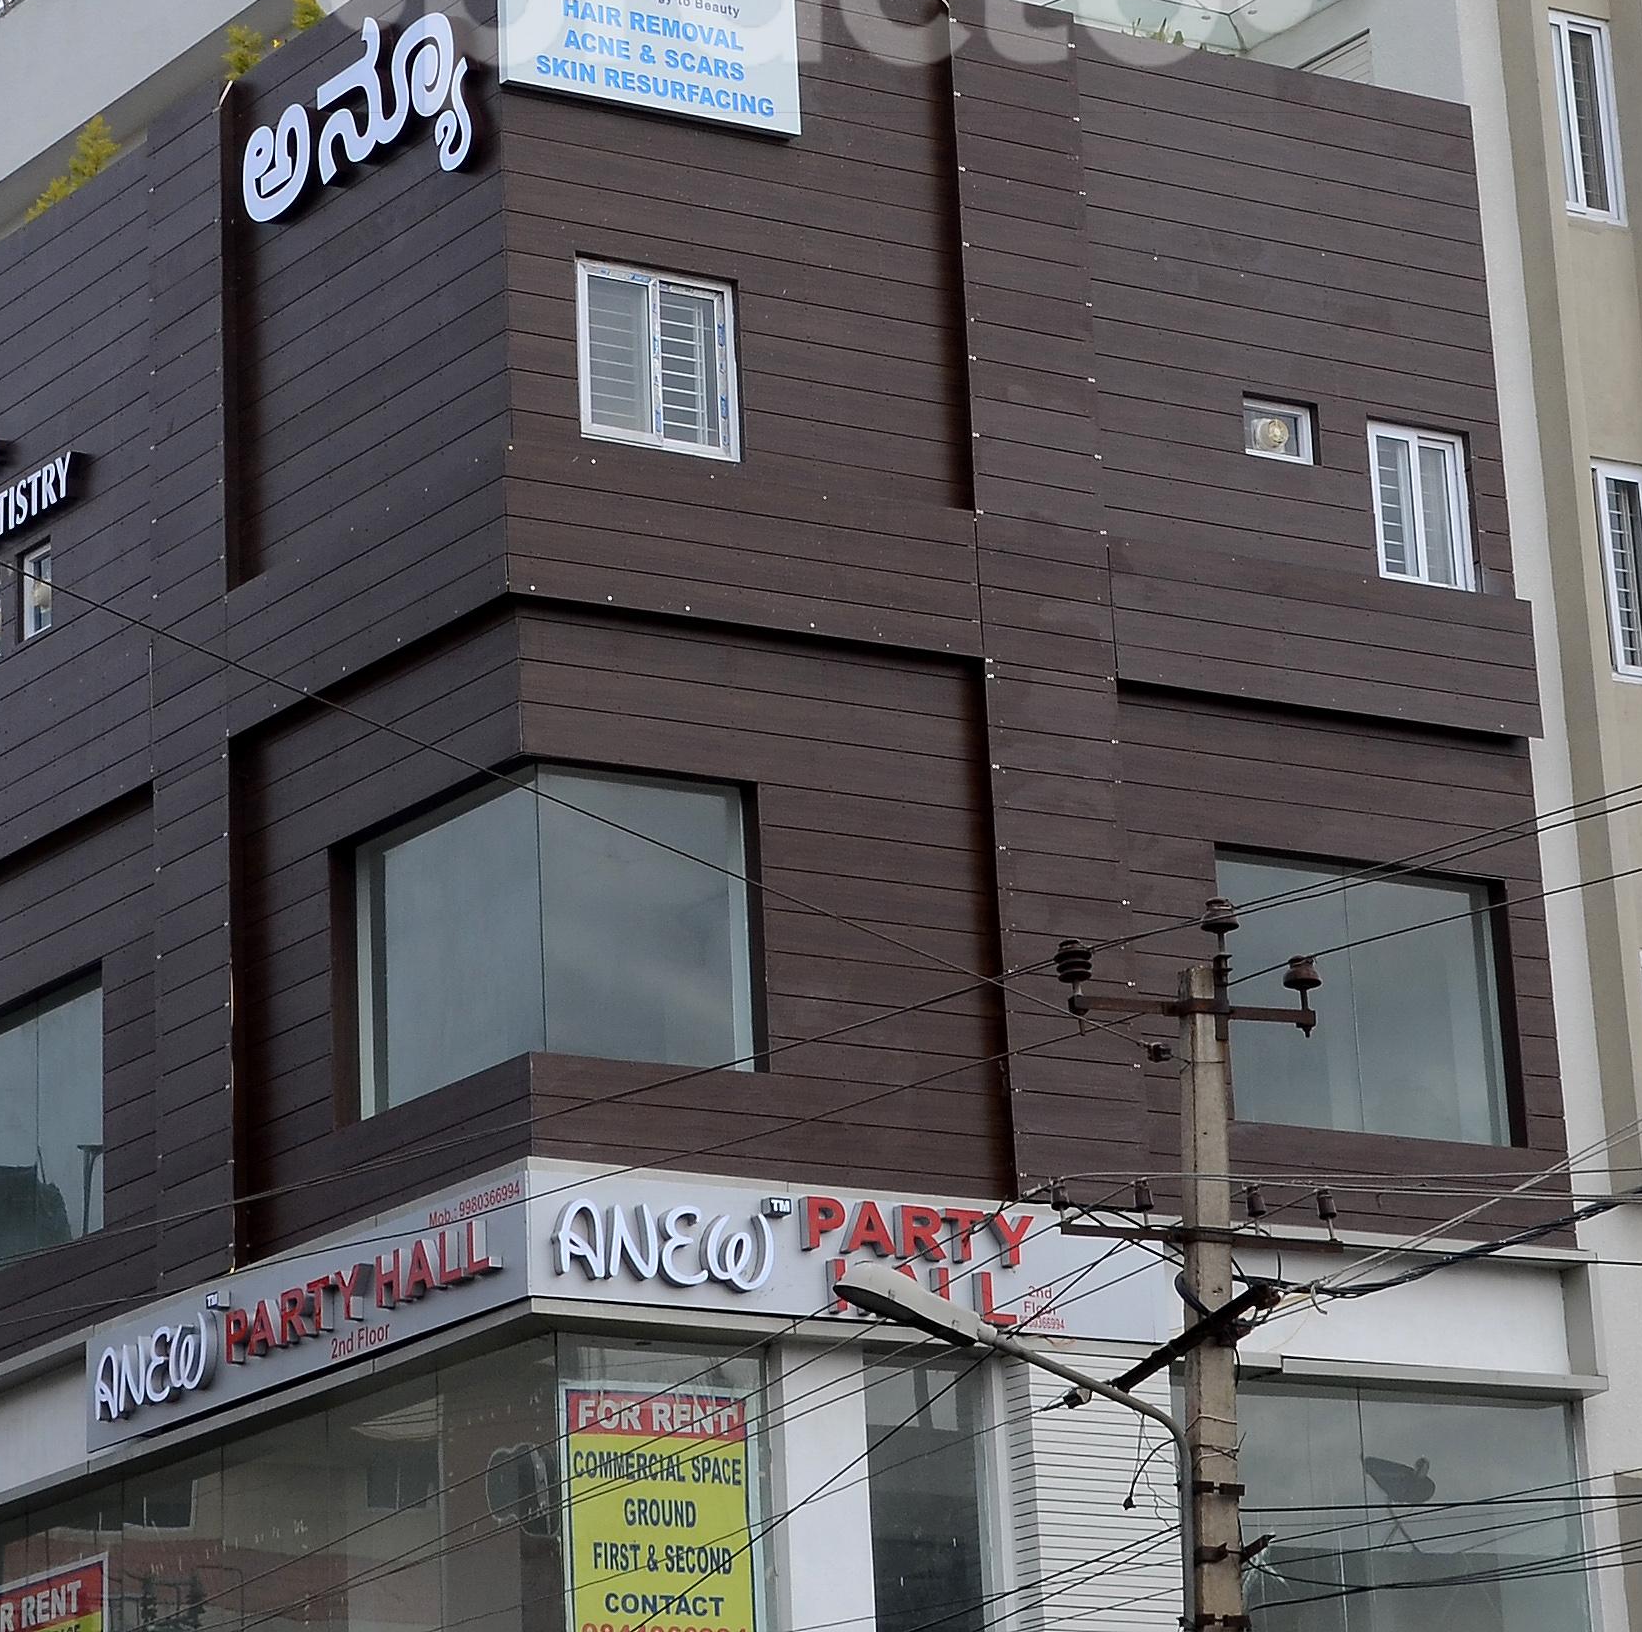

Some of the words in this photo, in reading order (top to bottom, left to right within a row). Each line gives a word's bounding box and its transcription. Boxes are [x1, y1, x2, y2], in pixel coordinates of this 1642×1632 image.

[629, 11, 745, 52] REMOVAL
[564, 29, 631, 60] ACNE
[638, 43, 657, 65] &
[664, 49, 745, 82] SCARS
[536, 54, 596, 84] SKIN
[604, 67, 775, 118] RESURFACING
[555, 1198, 774, 1293] ANEW
[800, 1195, 1034, 1268] PARTY
[94, 1311, 208, 1422] ANEW
[224, 1263, 362, 1365] PARTY
[375, 1219, 493, 1309] HALL
[330, 1332, 355, 1360] 2nd
[357, 1322, 391, 1349] Floor
[578, 1400, 643, 1431] FOR
[652, 1402, 739, 1436] RENT
[573, 1450, 686, 1483] COMMERCIAL
[691, 1457, 742, 1486] SPACE
[623, 1497, 697, 1528] GROUND
[593, 1541, 641, 1572] FIRST
[646, 1544, 658, 1573] &
[665, 1544, 733, 1575] SECOND
[21, 1579, 82, 1629] RENT
[604, 1592, 725, 1617] CONTACT
